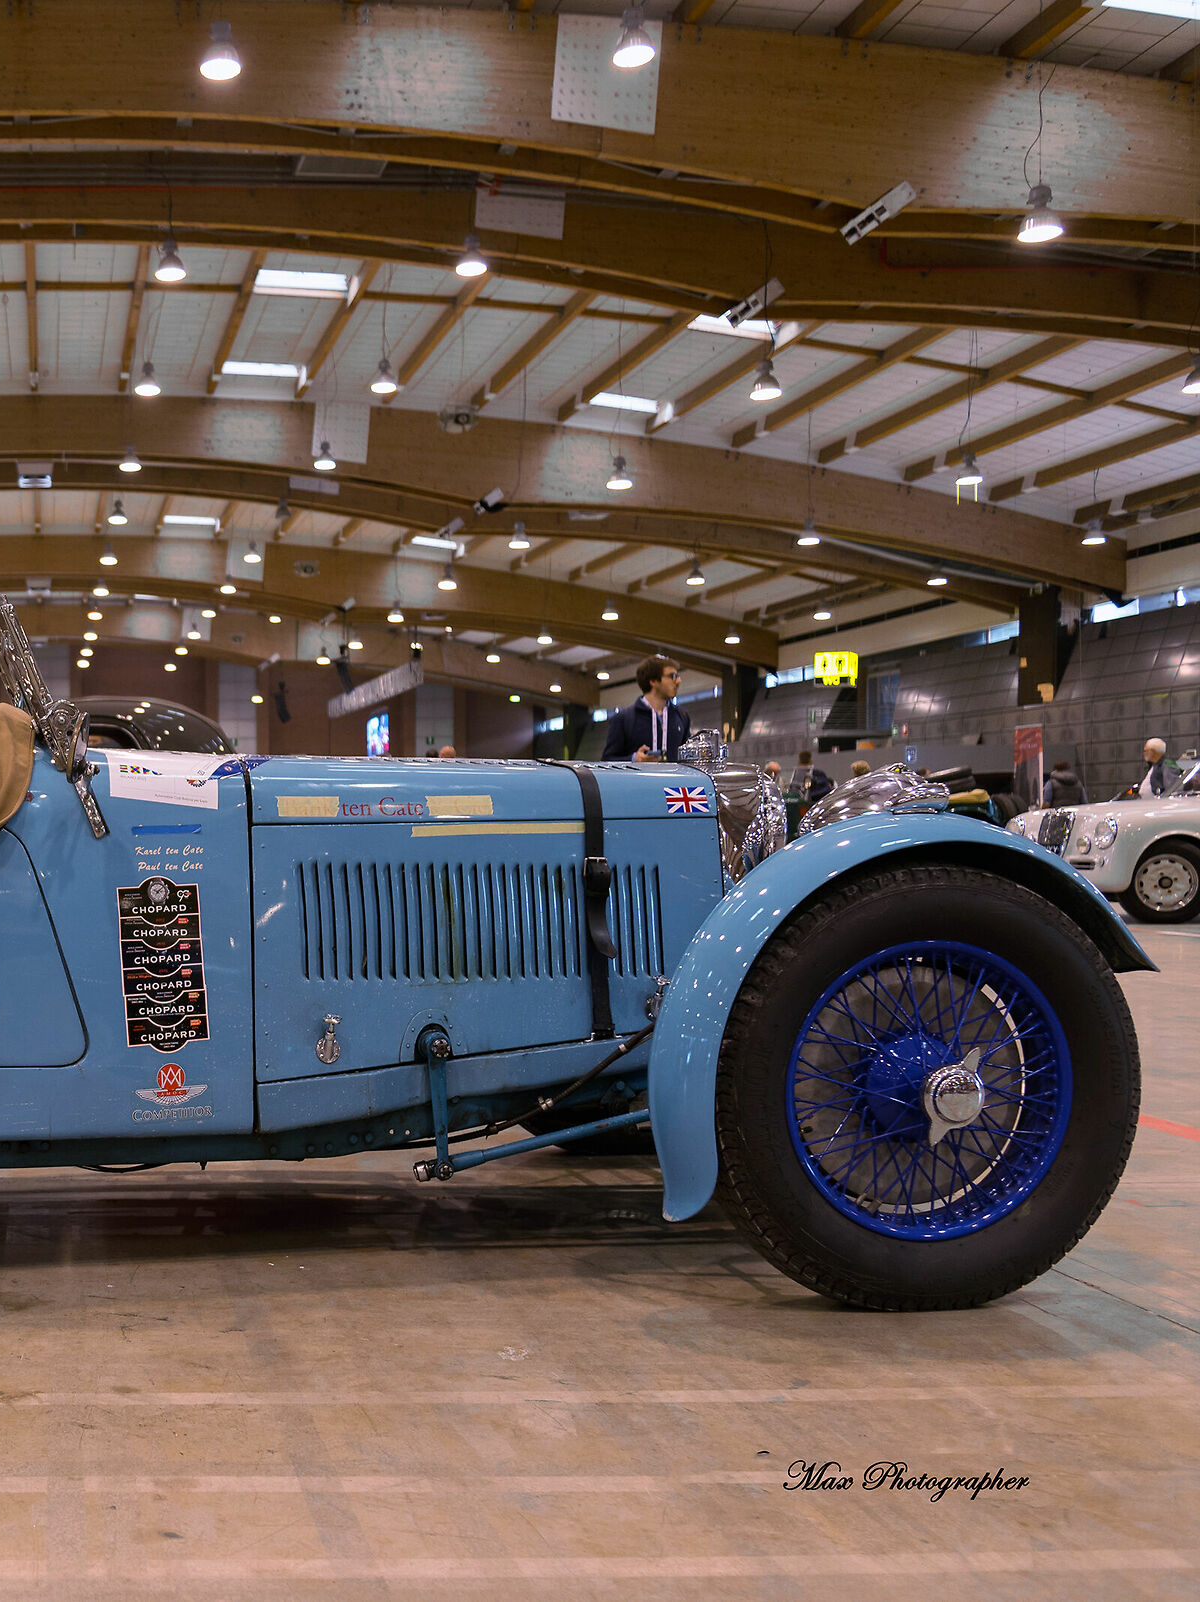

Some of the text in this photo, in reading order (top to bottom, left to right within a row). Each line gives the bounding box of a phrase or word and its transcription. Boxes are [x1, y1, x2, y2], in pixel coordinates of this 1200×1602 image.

[342, 803, 372, 816] ten
[378, 797, 424, 816] Cate
[134, 844, 204, 856] Karel ten Cate
[137, 860, 204, 872] Paul ten Cate
[131, 904, 187, 914] CHOPARD
[133, 928, 188, 937] CHOPARD
[134, 953, 191, 965] CHOPARD
[136, 980, 192, 991] CHOPARD
[138, 1005, 195, 1015] CHOPARD
[140, 1030, 197, 1042] CHOPARD
[132, 1105, 213, 1122] COMPETITOR
